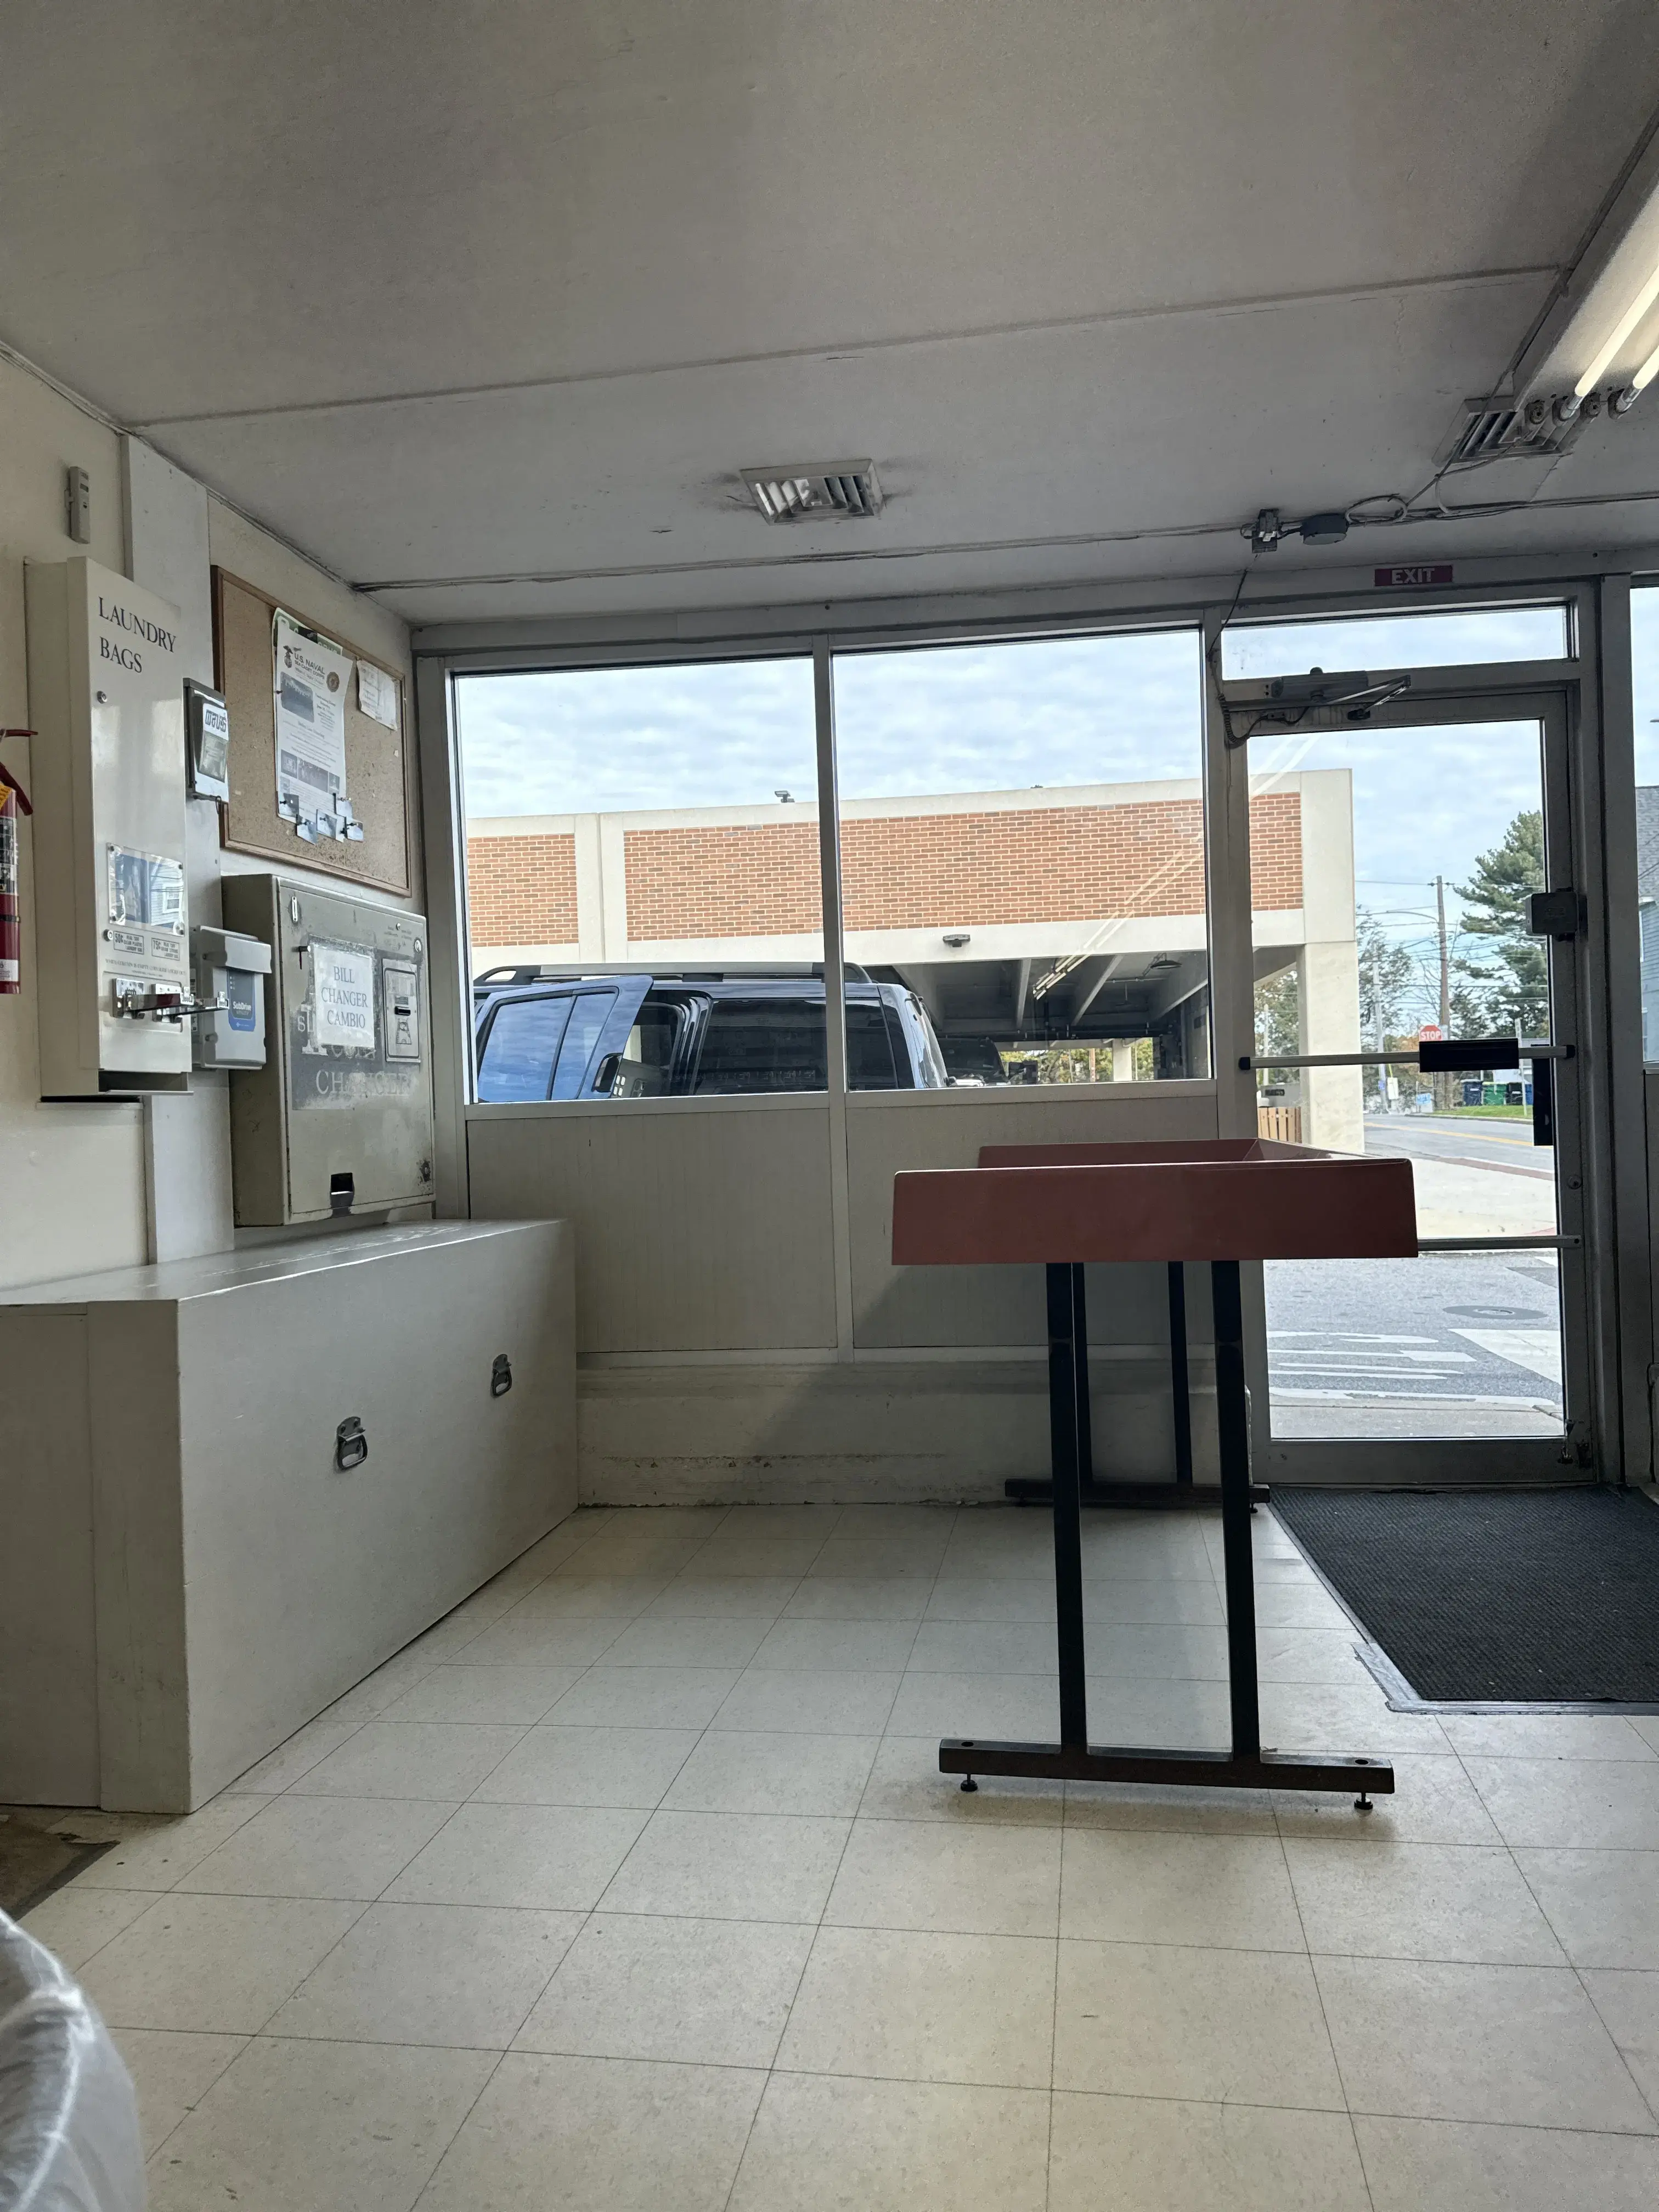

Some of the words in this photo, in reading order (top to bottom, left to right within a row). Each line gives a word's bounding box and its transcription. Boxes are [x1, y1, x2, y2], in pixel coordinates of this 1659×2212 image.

[1392, 568, 1435, 584] EXIT
[99, 596, 176, 653] LAUNDRY
[99, 636, 142, 673] BAGS
[305, 658, 325, 675] NAVAL
[334, 966, 354, 984] BILL
[233, 1001, 252, 1011] SubDrive
[321, 987, 368, 1008] CHANGER
[327, 1010, 365, 1029] CAMBIO
[1421, 1030, 1441, 1041] STOP
